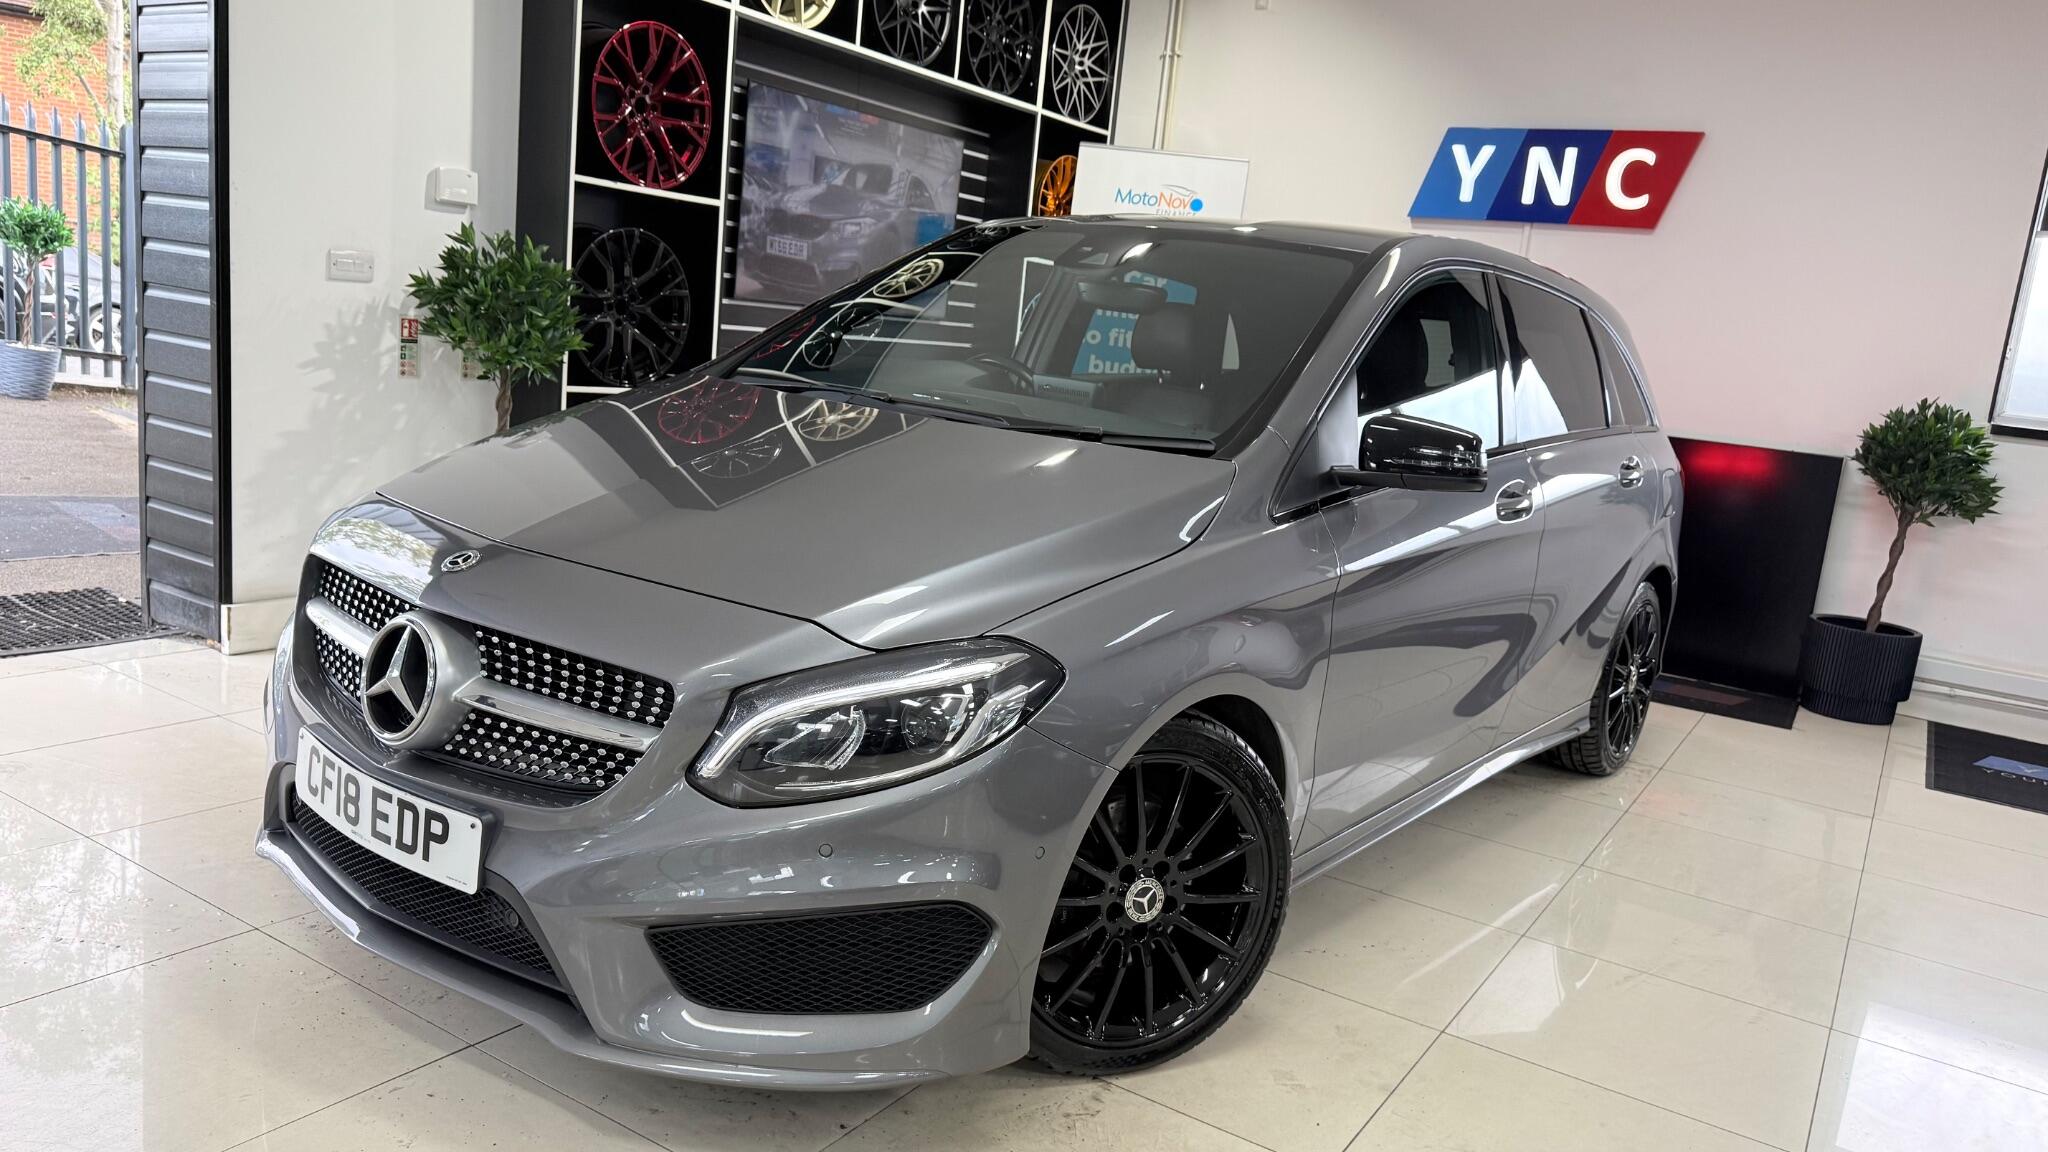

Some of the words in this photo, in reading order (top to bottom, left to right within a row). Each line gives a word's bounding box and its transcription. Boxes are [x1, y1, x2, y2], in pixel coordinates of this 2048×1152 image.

[1451, 143, 1657, 211] YNC
[1082, 329, 1102, 345] o
[307, 744, 361, 828] CF18
[370, 785, 450, 863] EDP
